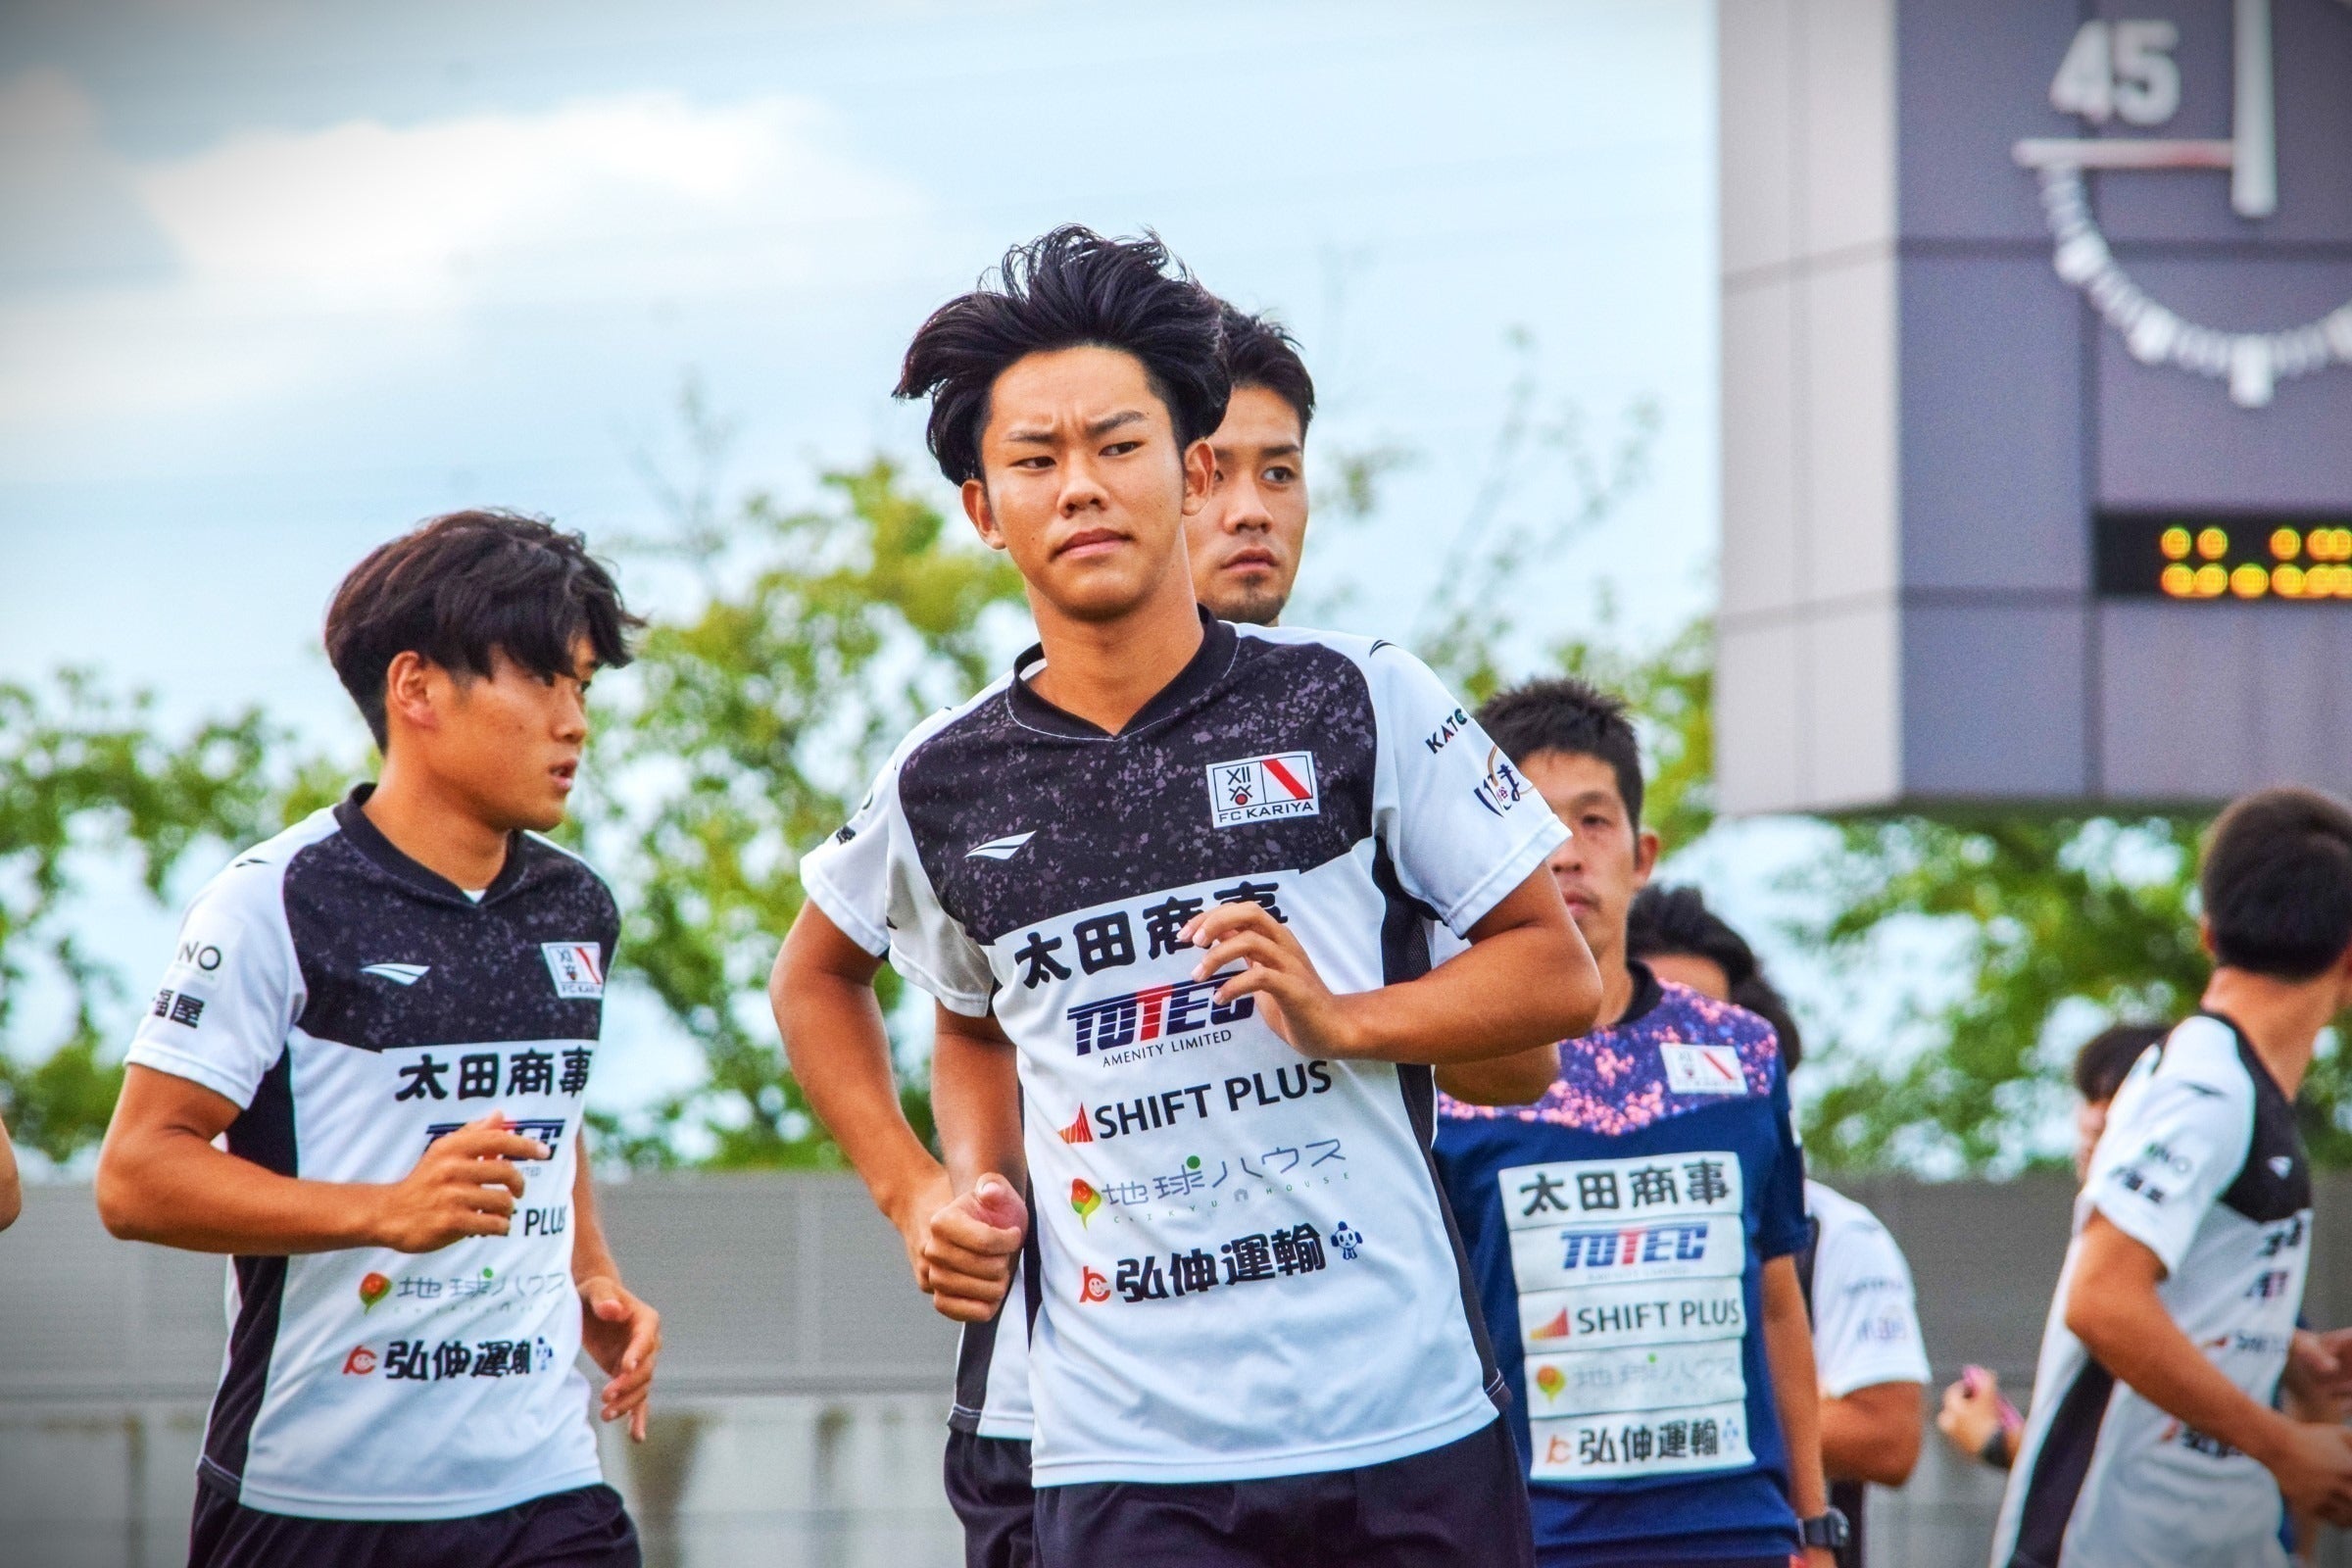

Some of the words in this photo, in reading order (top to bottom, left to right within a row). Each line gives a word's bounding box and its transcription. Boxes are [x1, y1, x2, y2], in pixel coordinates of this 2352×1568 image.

[2050, 20, 2180, 125] 45
[1226, 765, 1251, 785] XII
[1218, 810, 1242, 822] FC
[1247, 801, 1314, 818] KARIYA
[395, 1046, 593, 1102] 太田商事
[1102, 1043, 1164, 1068] AMENITY
[1171, 1029, 1232, 1053] LIMITED
[1095, 1083, 1212, 1140] SHIFT
[1224, 1059, 1333, 1112] PLUS
[1102, 1139, 1347, 1206] 地球ハウス
[1265, 1172, 1350, 1196] HOUSE
[1520, 1158, 1730, 1216] 太田商事
[1116, 1222, 1327, 1303] 弘伸運輸
[1561, 1221, 1709, 1269] TOTEC
[1577, 1302, 1672, 1334] SHIFT
[1682, 1298, 1741, 1327] PLUS
